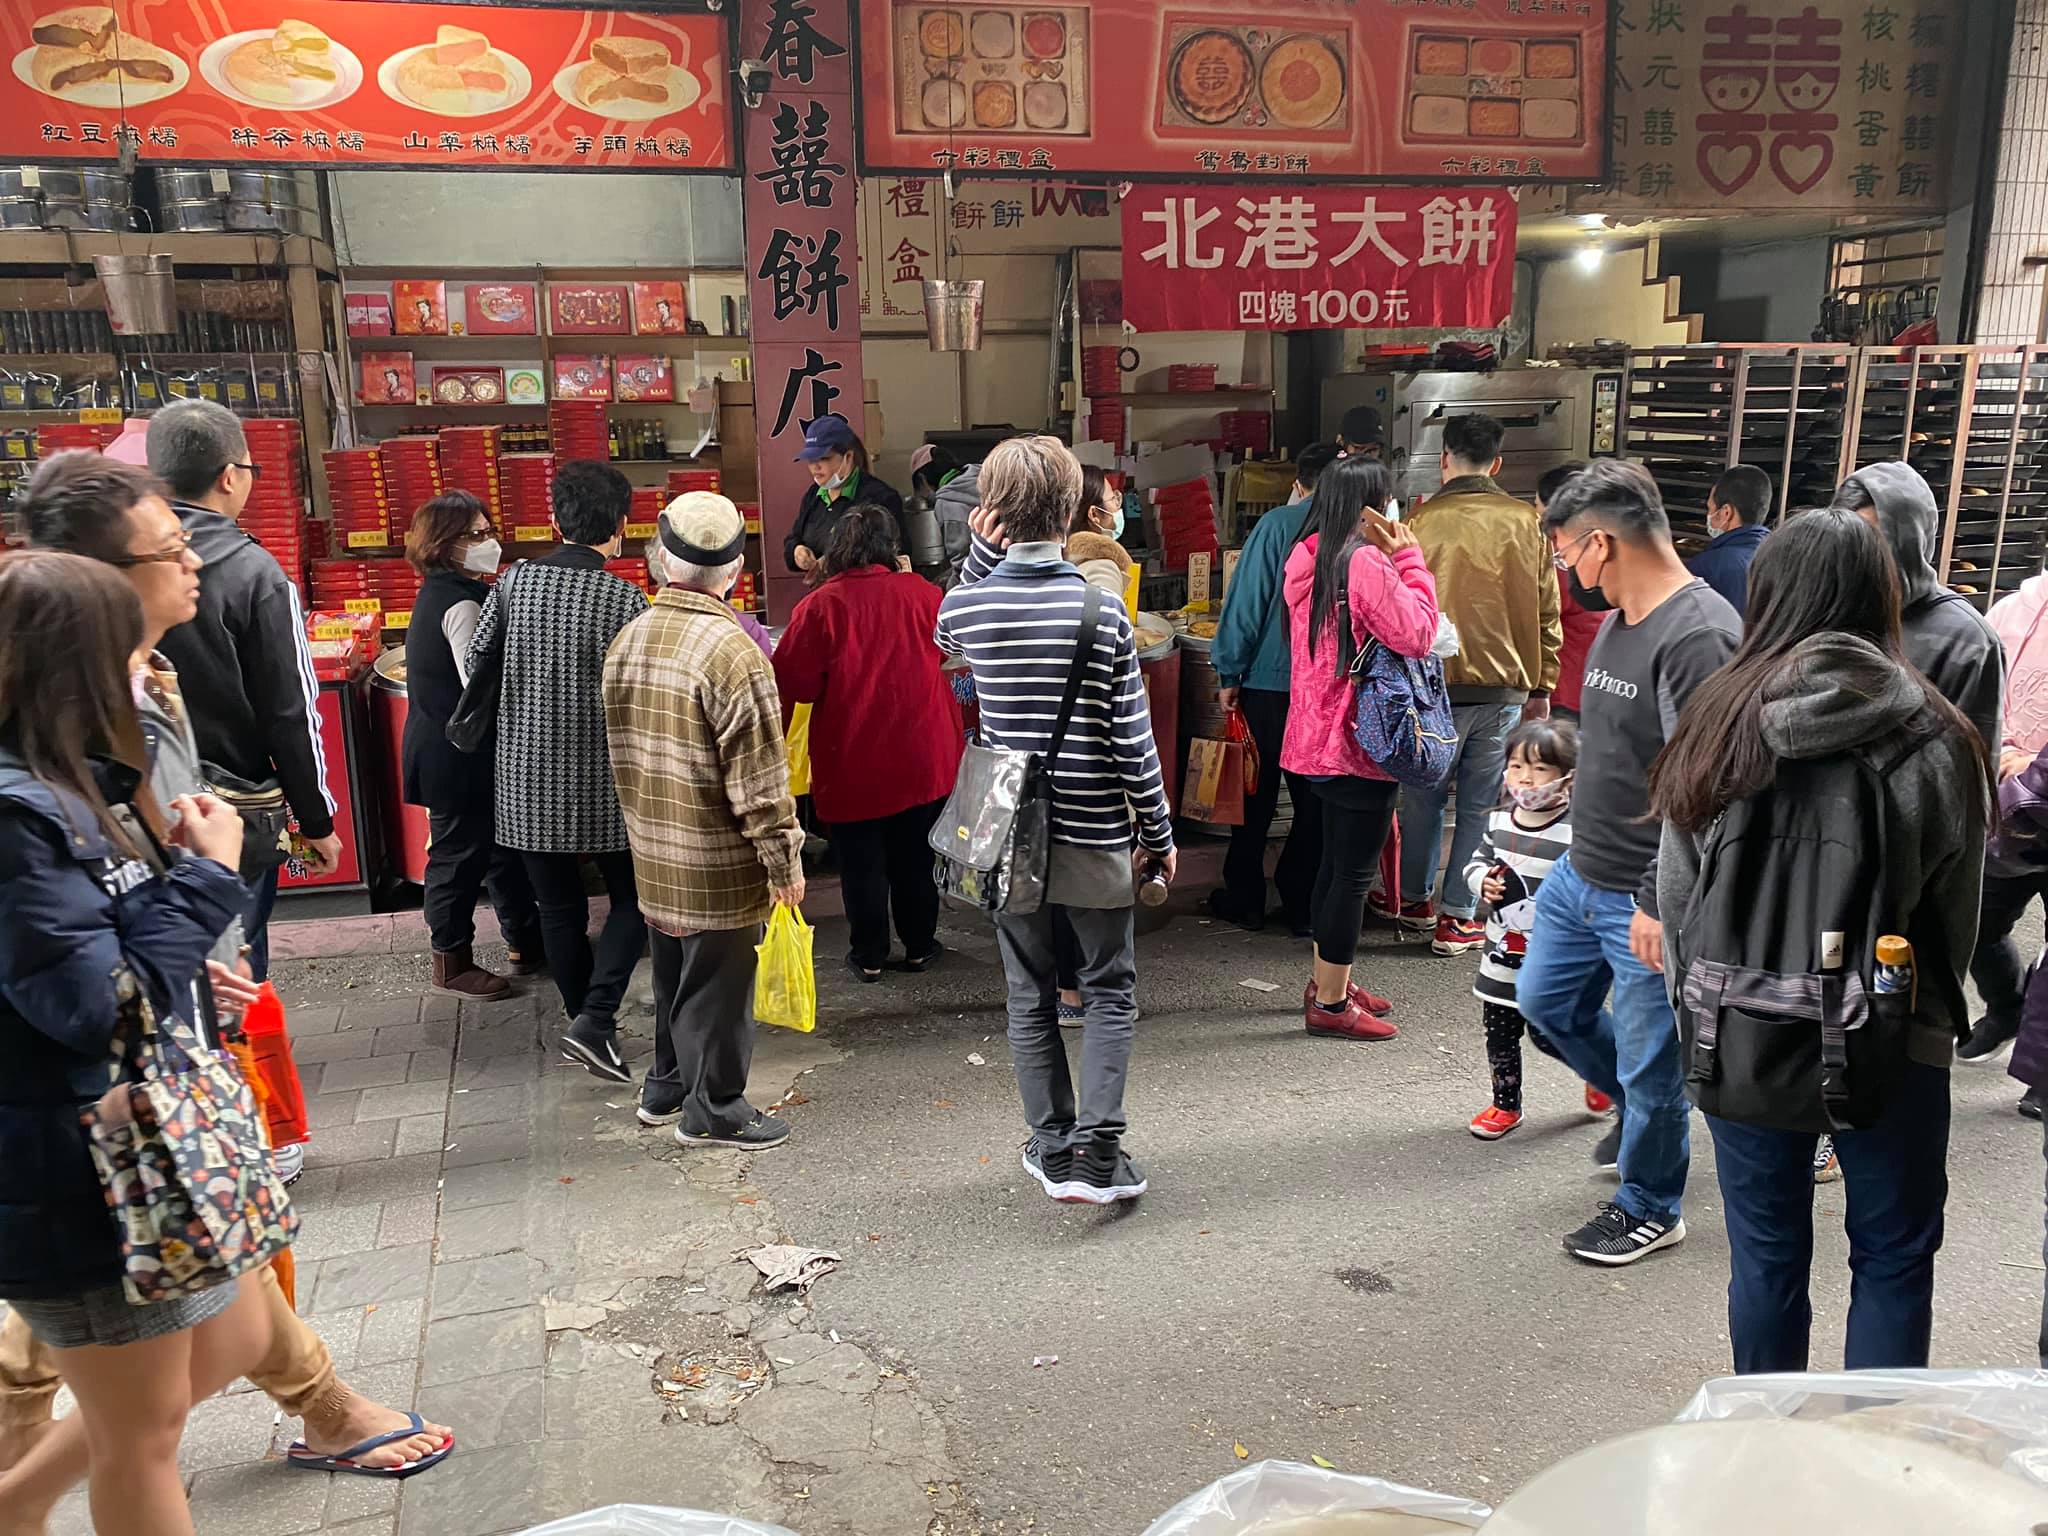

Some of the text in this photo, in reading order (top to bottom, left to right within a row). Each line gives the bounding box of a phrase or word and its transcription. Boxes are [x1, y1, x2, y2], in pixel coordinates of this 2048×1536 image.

[1848, 6, 1900, 198] 核桃蛋黃
[931, 148, 1055, 170] 六彩禮盒
[1195, 149, 1311, 173] 鴛鴦對餅
[1440, 156, 1547, 176] 六彩禮盒
[1141, 196, 1497, 270] 北港大餅
[1239, 288, 1409, 324] 四塊100元
